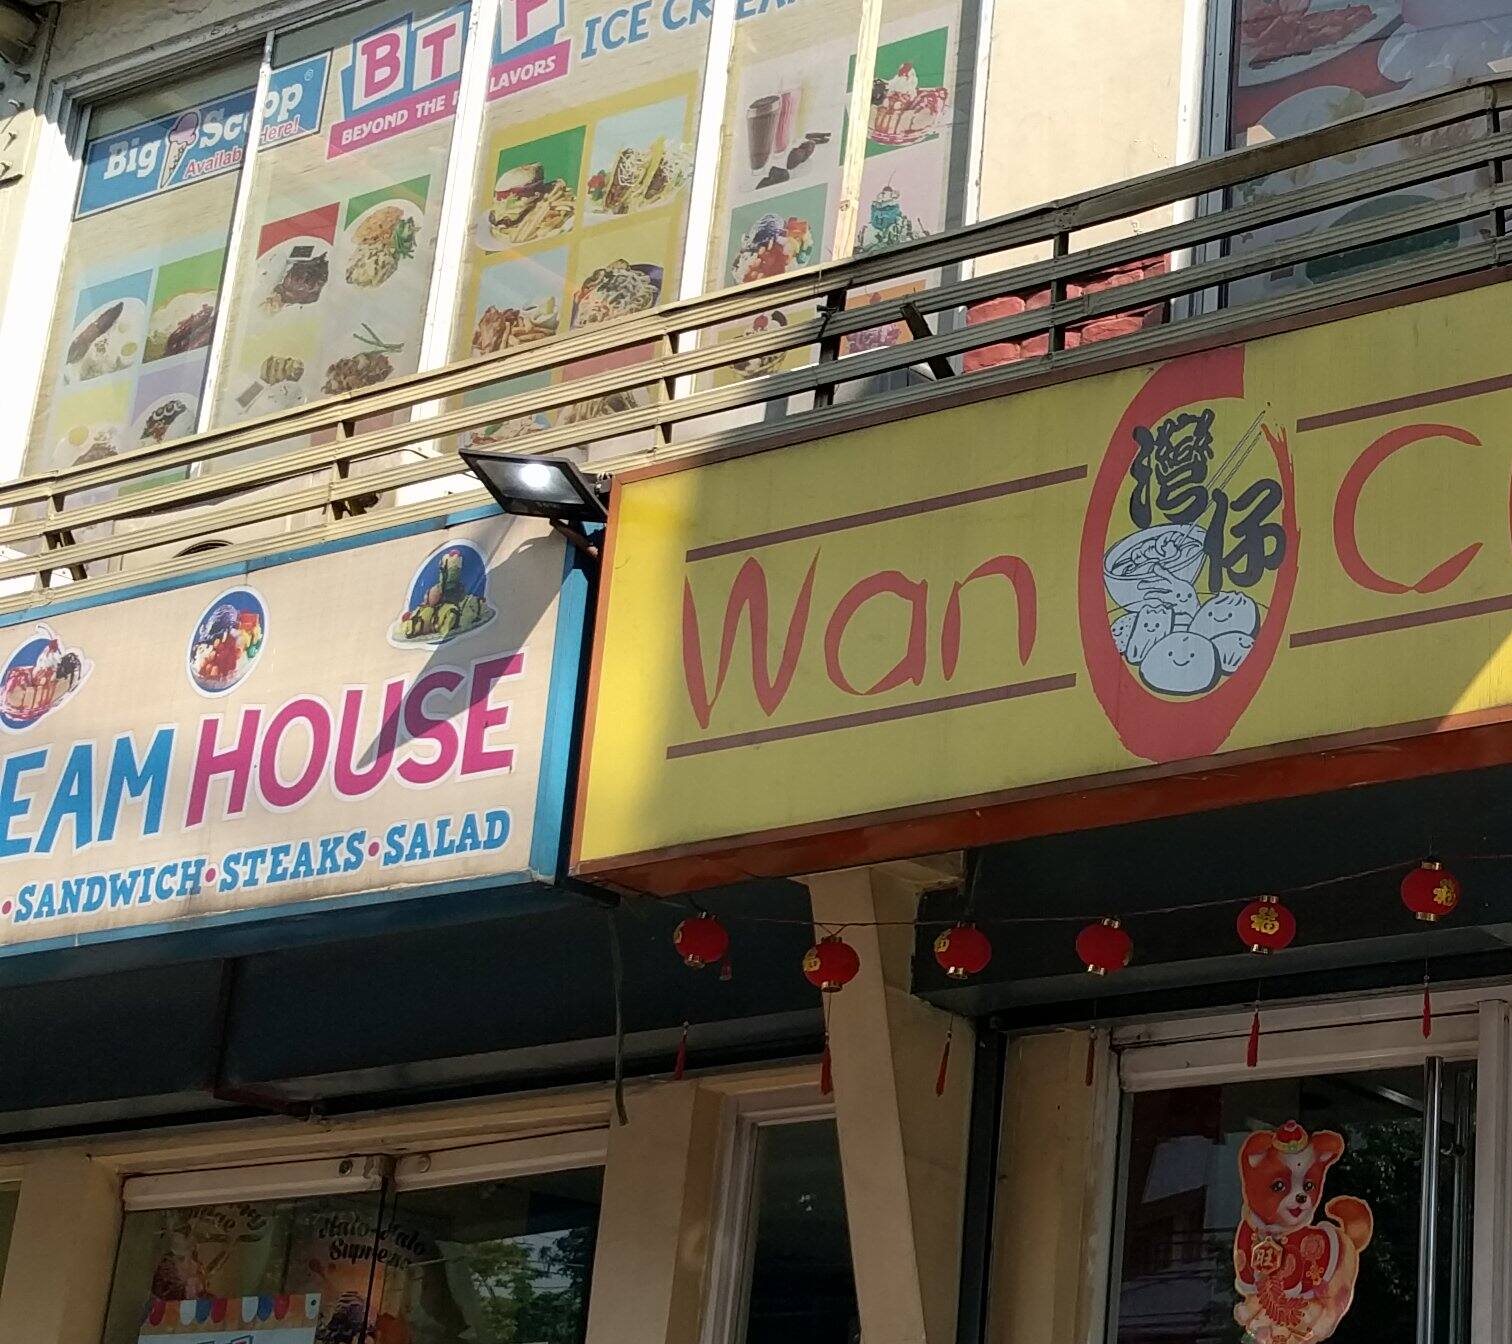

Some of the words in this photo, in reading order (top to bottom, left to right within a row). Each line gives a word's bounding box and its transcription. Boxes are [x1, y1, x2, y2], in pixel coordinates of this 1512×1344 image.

[581, 0, 653, 60] ICE
[103, 137, 161, 180] Big
[198, 83, 304, 149] Scop
[341, 109, 409, 146] BEYOND
[415, 94, 446, 119] THE
[680, 549, 1037, 734] Wan
[184, 652, 525, 828] HOUSE
[13, 858, 205, 924] SANDWICH
[218, 828, 366, 894] STEAKS
[381, 809, 511, 867] SALAD
